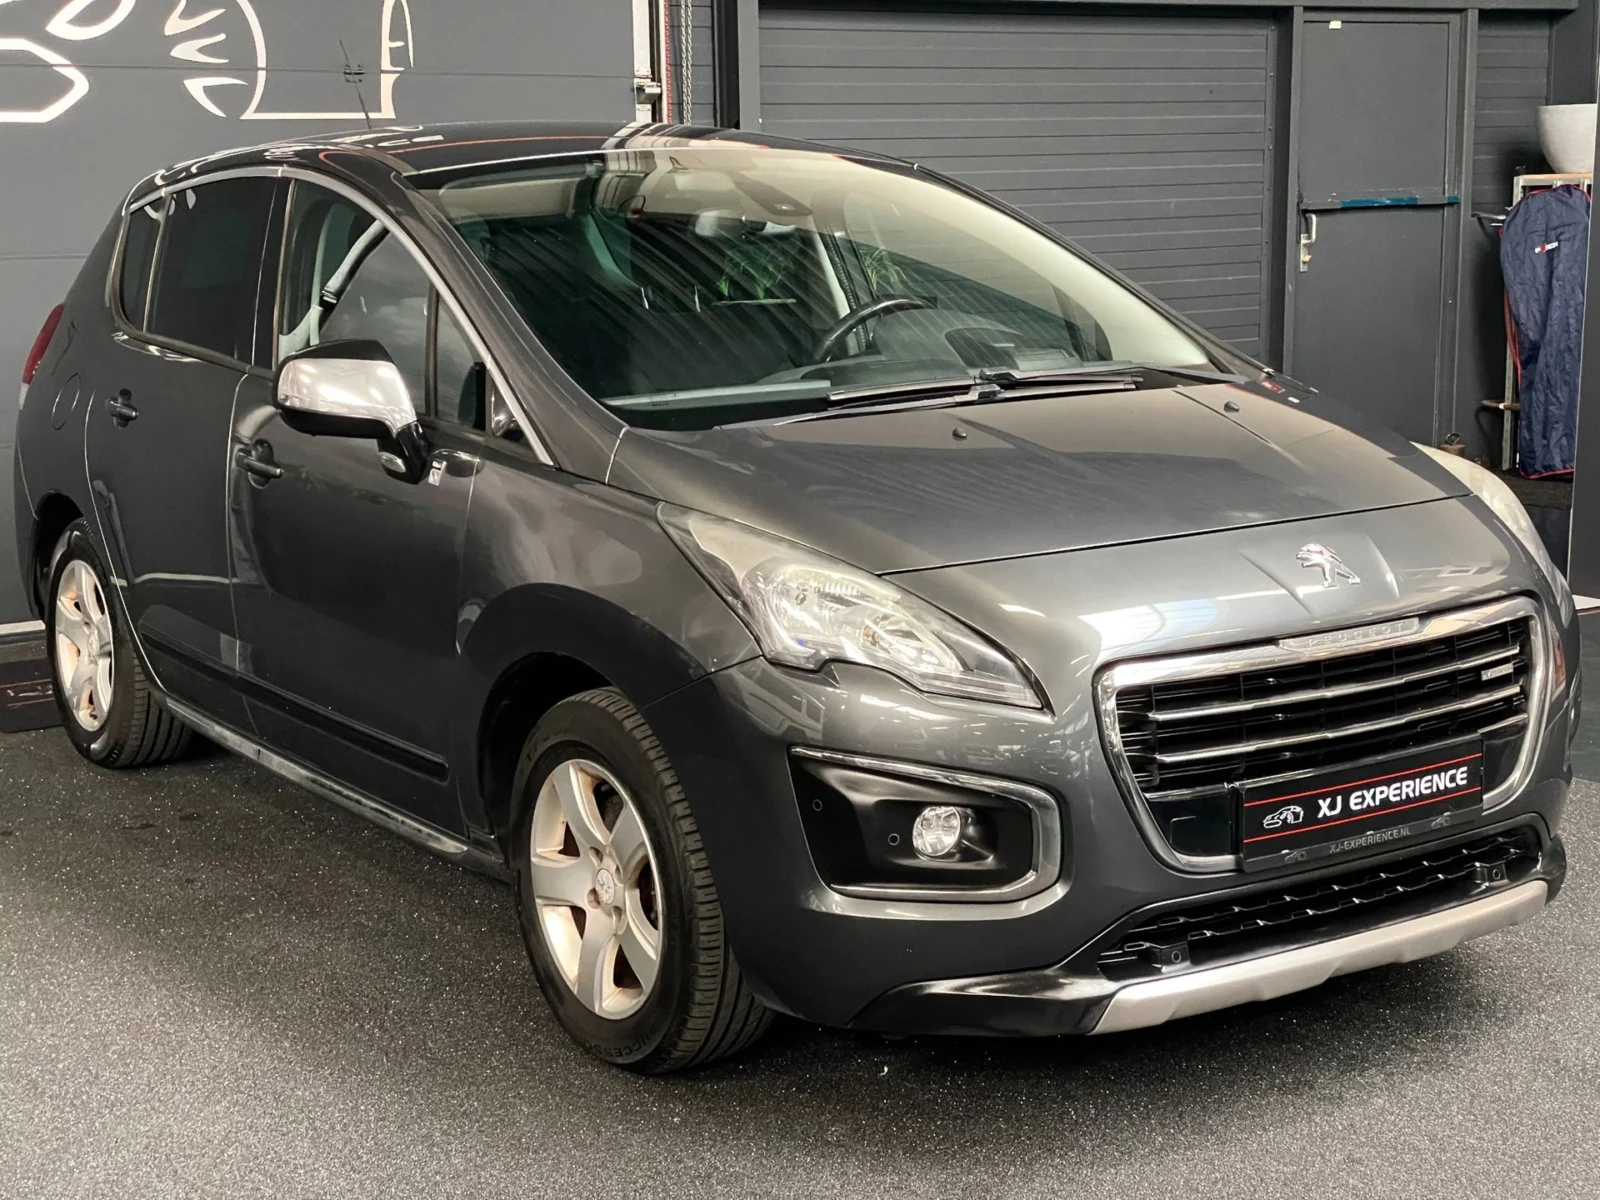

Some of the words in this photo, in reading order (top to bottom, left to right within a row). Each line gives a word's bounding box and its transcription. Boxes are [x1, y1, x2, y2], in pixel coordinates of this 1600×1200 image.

[1308, 622, 1404, 647] PEUGEOT
[1317, 795, 1342, 818] XJ
[1349, 766, 1468, 810] EXPERIENCE
[1329, 827, 1411, 853] XJ-EXPERIENCE.NL
